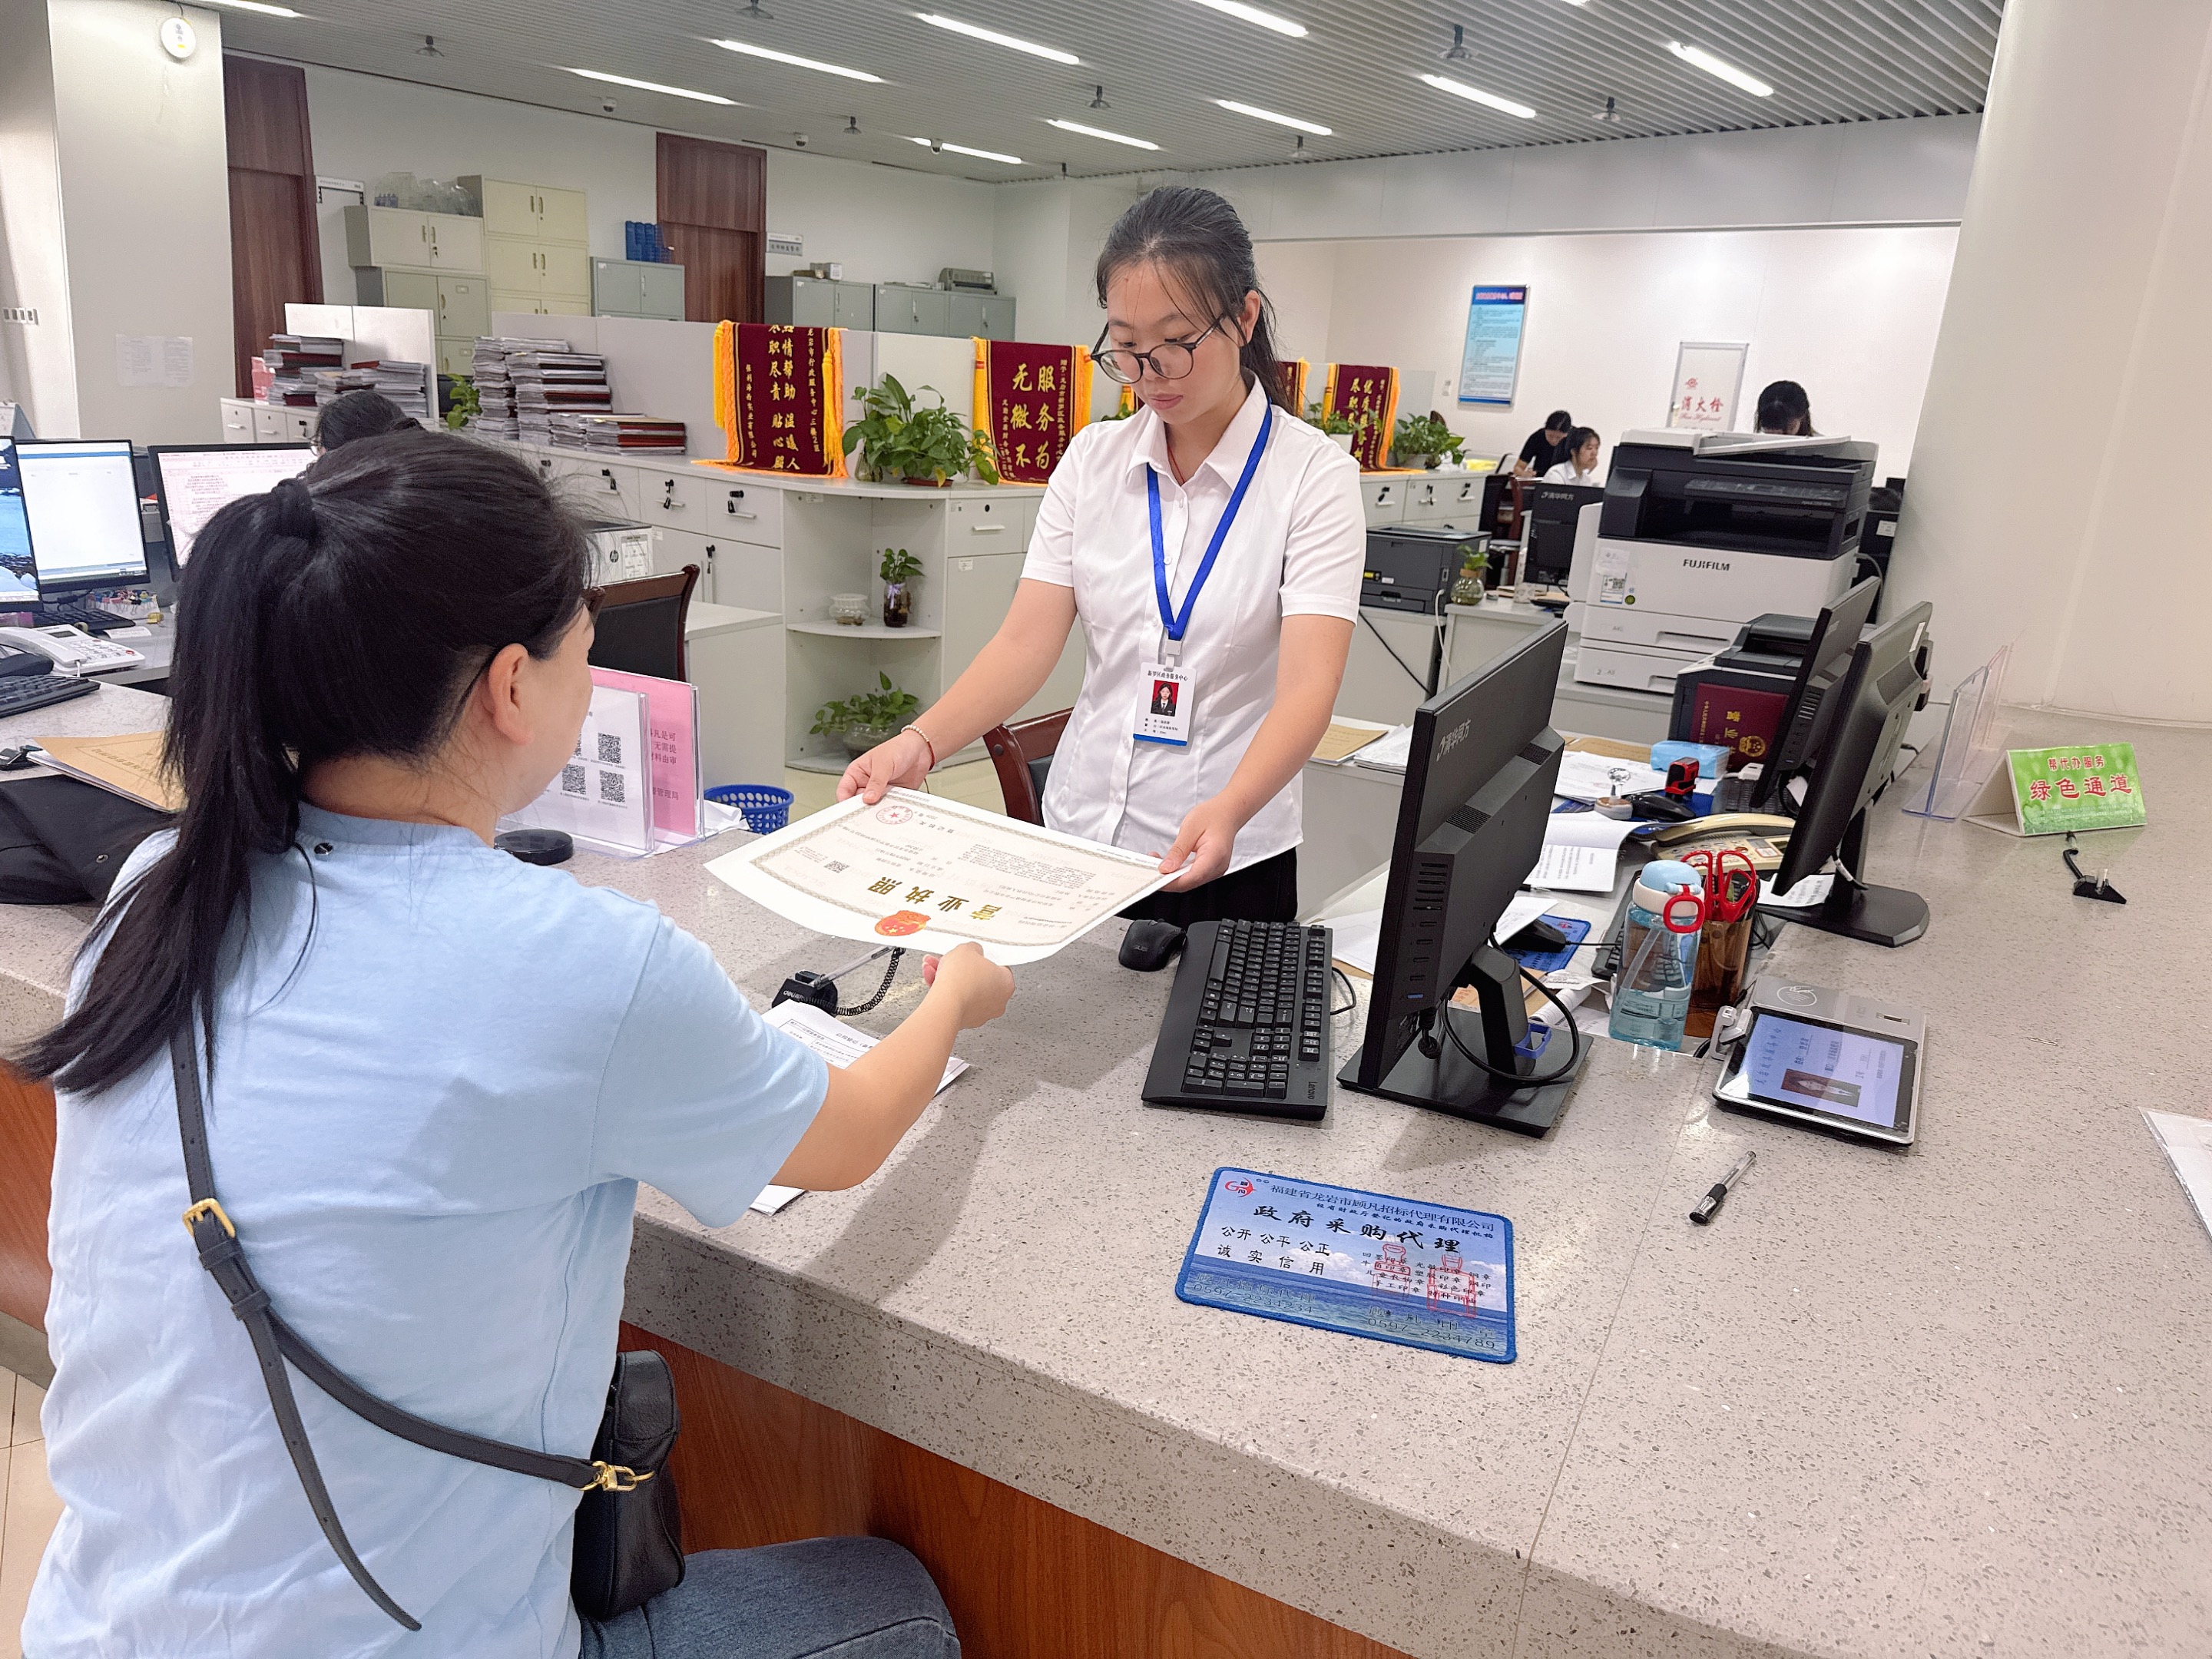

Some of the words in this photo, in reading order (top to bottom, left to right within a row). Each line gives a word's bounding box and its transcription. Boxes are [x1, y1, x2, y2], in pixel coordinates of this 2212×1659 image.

[1010, 363, 1032, 468] 无微不
[1035, 365, 1056, 469] 服务为
[1683, 558, 1730, 572] FUJIFILM
[654, 741, 677, 754] 无需提
[2048, 755, 2104, 771] 帮代办服务
[2030, 773, 2133, 801] 绿色通道
[866, 874, 1005, 922] 营业执照
[1307, 1081, 1317, 1100] Lenovo
[1270, 1184, 1495, 1231] 福建省龙岩市顾凡招标代理有限公司
[1221, 1225, 1252, 1241] 公开
[1260, 1232, 1291, 1249] 公平
[1299, 1239, 1331, 1257] 公正
[1254, 1204, 1461, 1253] 政府采购代理
[1217, 1243, 1324, 1276] 诚实信用
